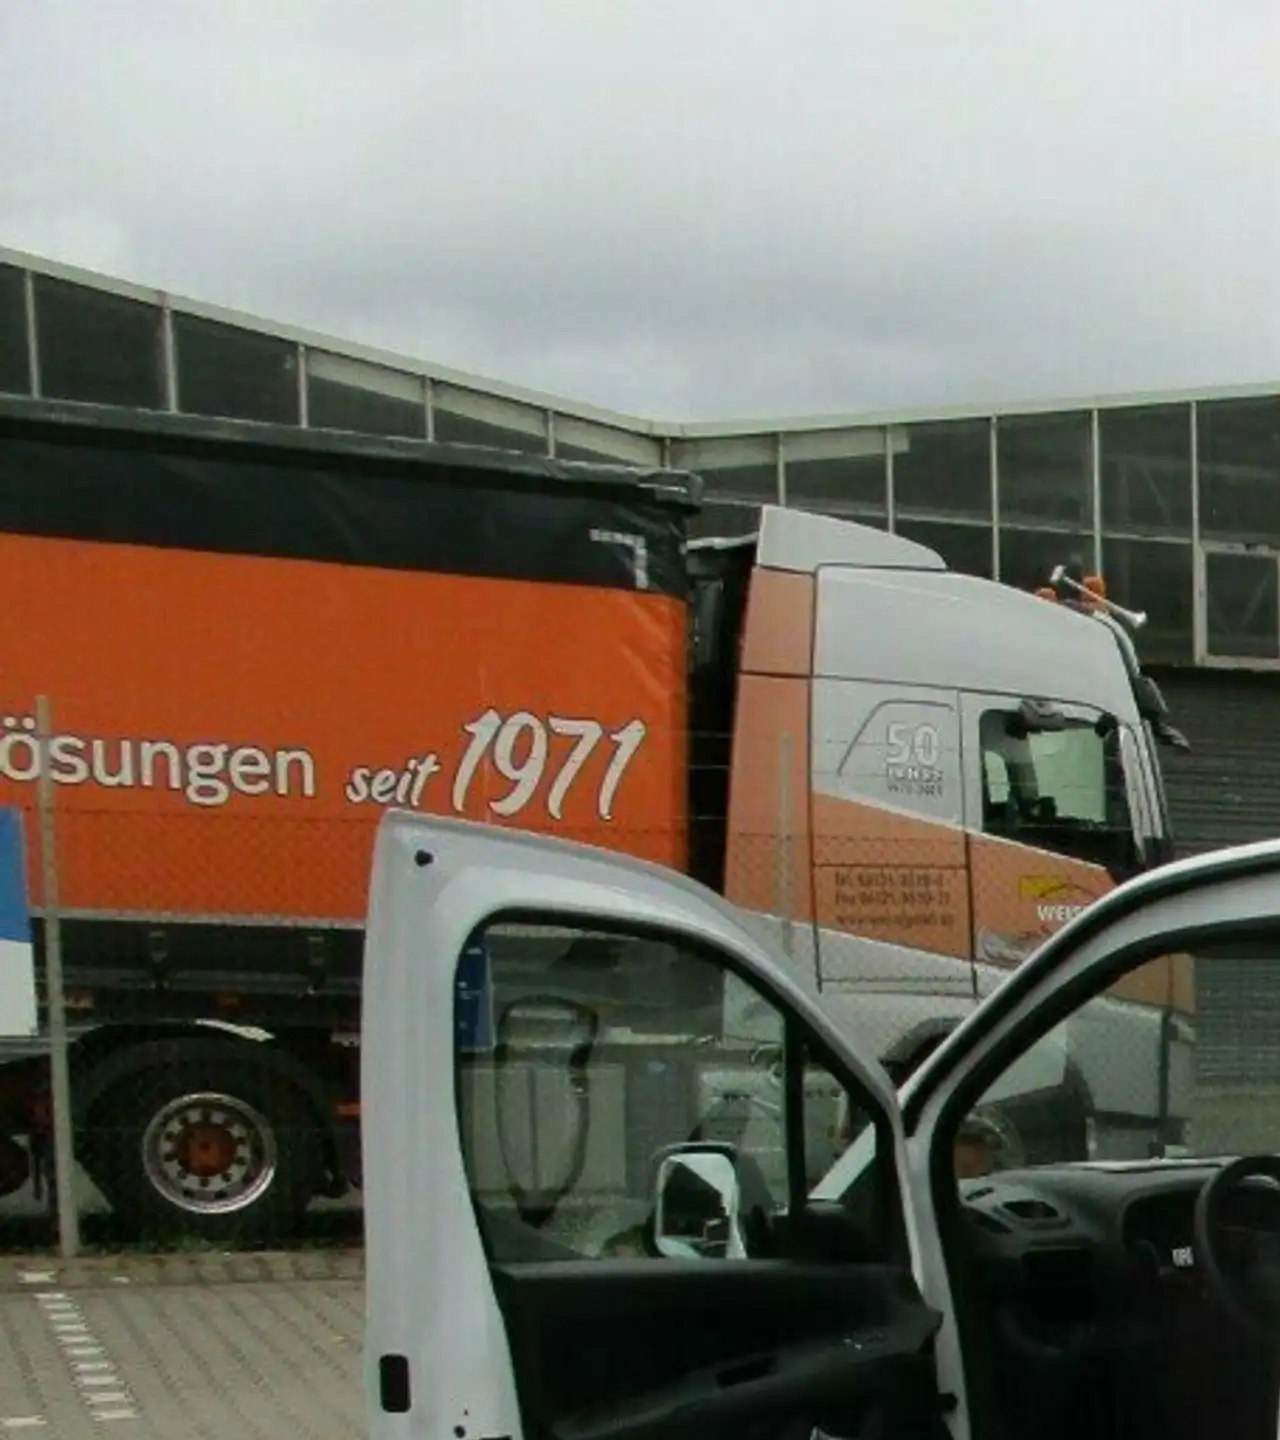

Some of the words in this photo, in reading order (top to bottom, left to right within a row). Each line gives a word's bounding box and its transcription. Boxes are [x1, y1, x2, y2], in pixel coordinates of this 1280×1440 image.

[345, 752, 442, 808] seit
[451, 708, 647, 821] 1971
[885, 721, 941, 767] 50
